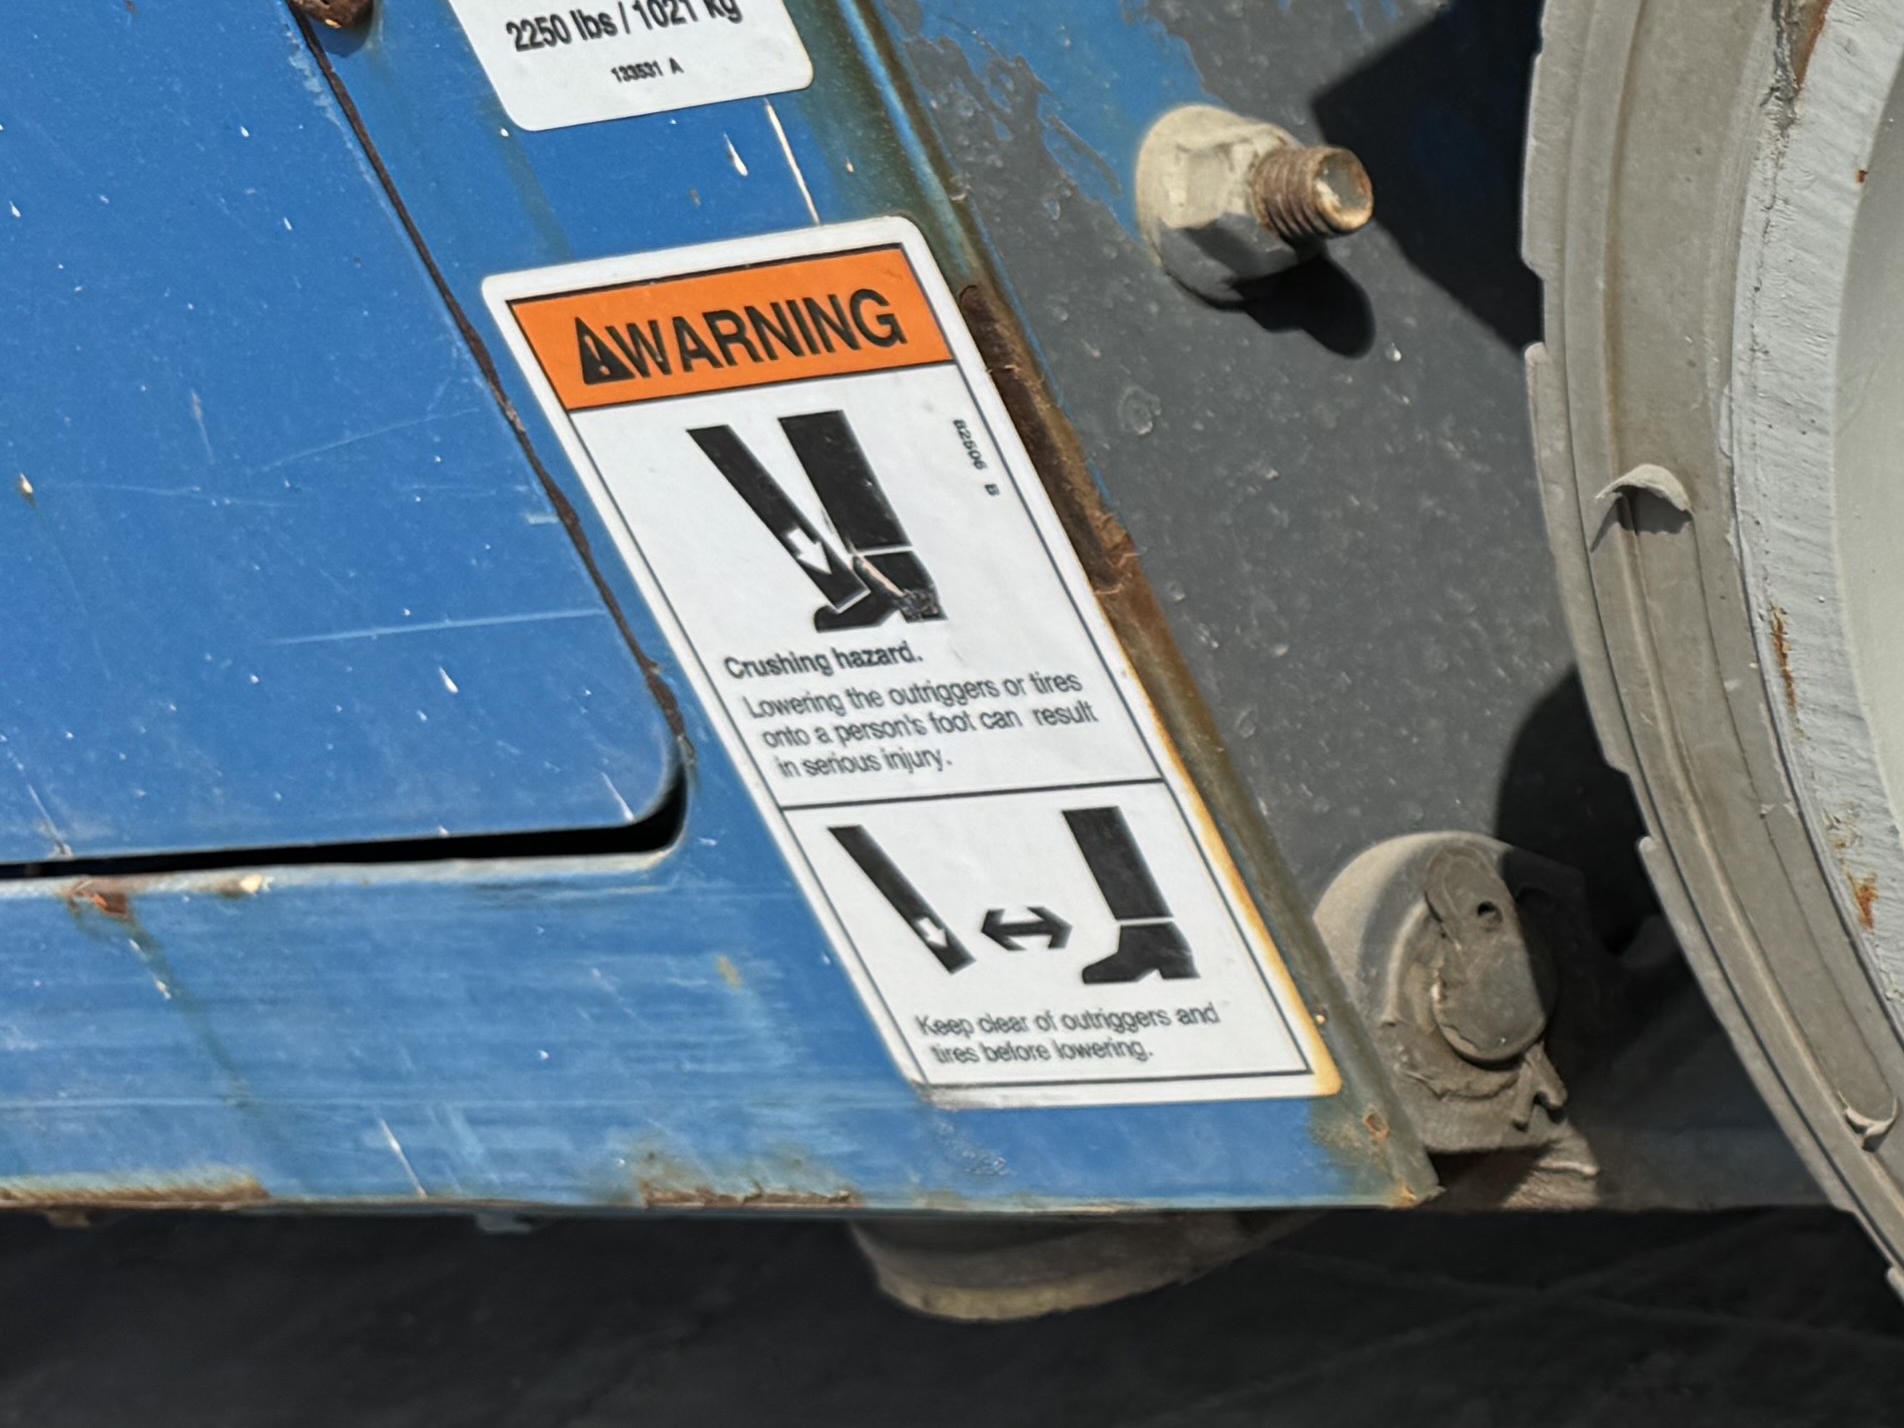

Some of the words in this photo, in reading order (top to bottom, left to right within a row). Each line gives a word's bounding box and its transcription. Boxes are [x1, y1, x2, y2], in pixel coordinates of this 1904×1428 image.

[506, 14, 572, 52] 2250
[570, 9, 618, 40] lbs
[617, 1, 631, 35] /
[668, 57, 684, 74] A
[605, 288, 908, 378] WARNING
[724, 649, 834, 680] Crushing
[835, 640, 924, 670] hazard.
[742, 690, 847, 720] Lowering
[847, 686, 885, 710] the
[889, 677, 1000, 706] outriggers
[1002, 676, 1026, 697] or
[1028, 671, 1084, 695] tires
[761, 723, 811, 749] onto
[815, 725, 832, 743] a
[835, 714, 928, 747] person's
[928, 711, 974, 734] foot
[979, 709, 1024, 730] can
[1031, 699, 1099, 726] result
[774, 754, 800, 780] in
[803, 750, 882, 777] serious
[883, 746, 953, 775] injury.
[914, 1013, 975, 1039] Keep
[978, 1011, 1029, 1034] clear
[1035, 1009, 1059, 1032] of
[1061, 1007, 1172, 1033] outriggers
[1175, 1002, 1222, 1025] and
[929, 1042, 980, 1064] tires
[979, 1040, 1051, 1064] before
[1051, 1035, 1155, 1062] lowering.
